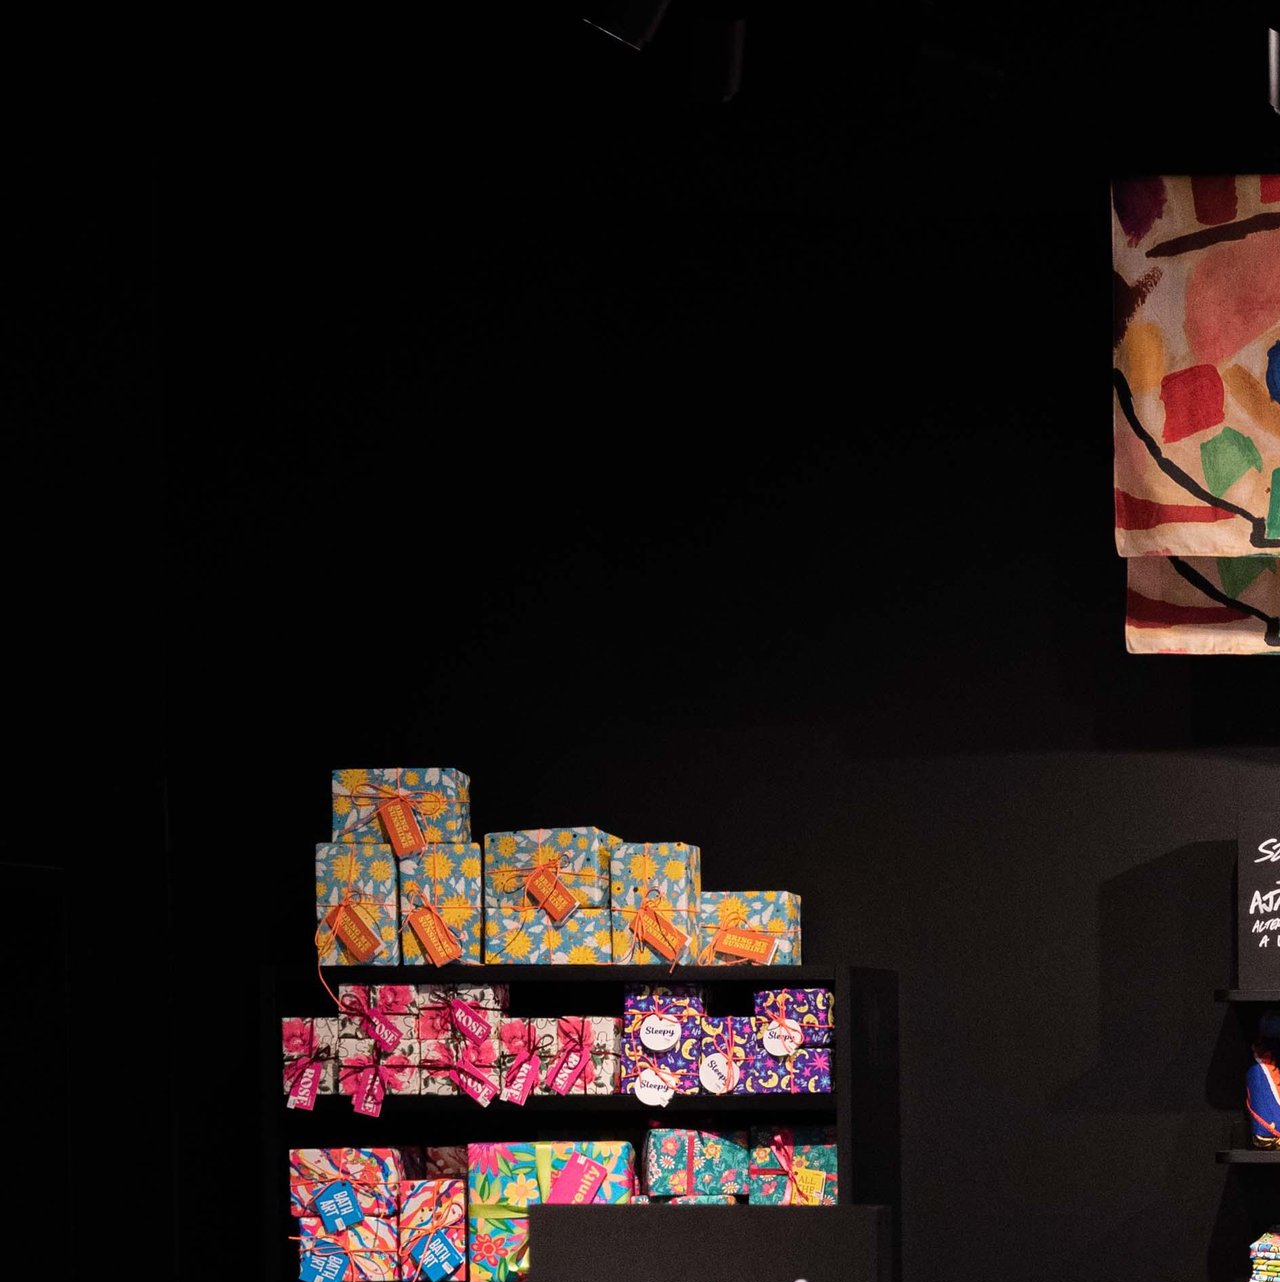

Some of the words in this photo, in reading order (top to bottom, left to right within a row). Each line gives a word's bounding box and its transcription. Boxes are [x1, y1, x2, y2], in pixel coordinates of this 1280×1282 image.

[1259, 936, 1270, 948] A
[454, 1007, 489, 1041] ROSE
[644, 1026, 675, 1038] Sleepy
[767, 1030, 796, 1042] Sleepy
[509, 1062, 533, 1104] ROSE
[553, 1051, 582, 1091] ROSE
[706, 1059, 728, 1087] Sleepy
[296, 1067, 317, 1107] ROSE
[640, 1078, 670, 1094] Sleepy
[800, 1175, 817, 1185] ALL
[319, 1199, 340, 1217] ART
[333, 1190, 354, 1216] BATH
[419, 1249, 438, 1268] ART
[428, 1237, 452, 1263] BATH
[322, 1255, 344, 1281] BATH
